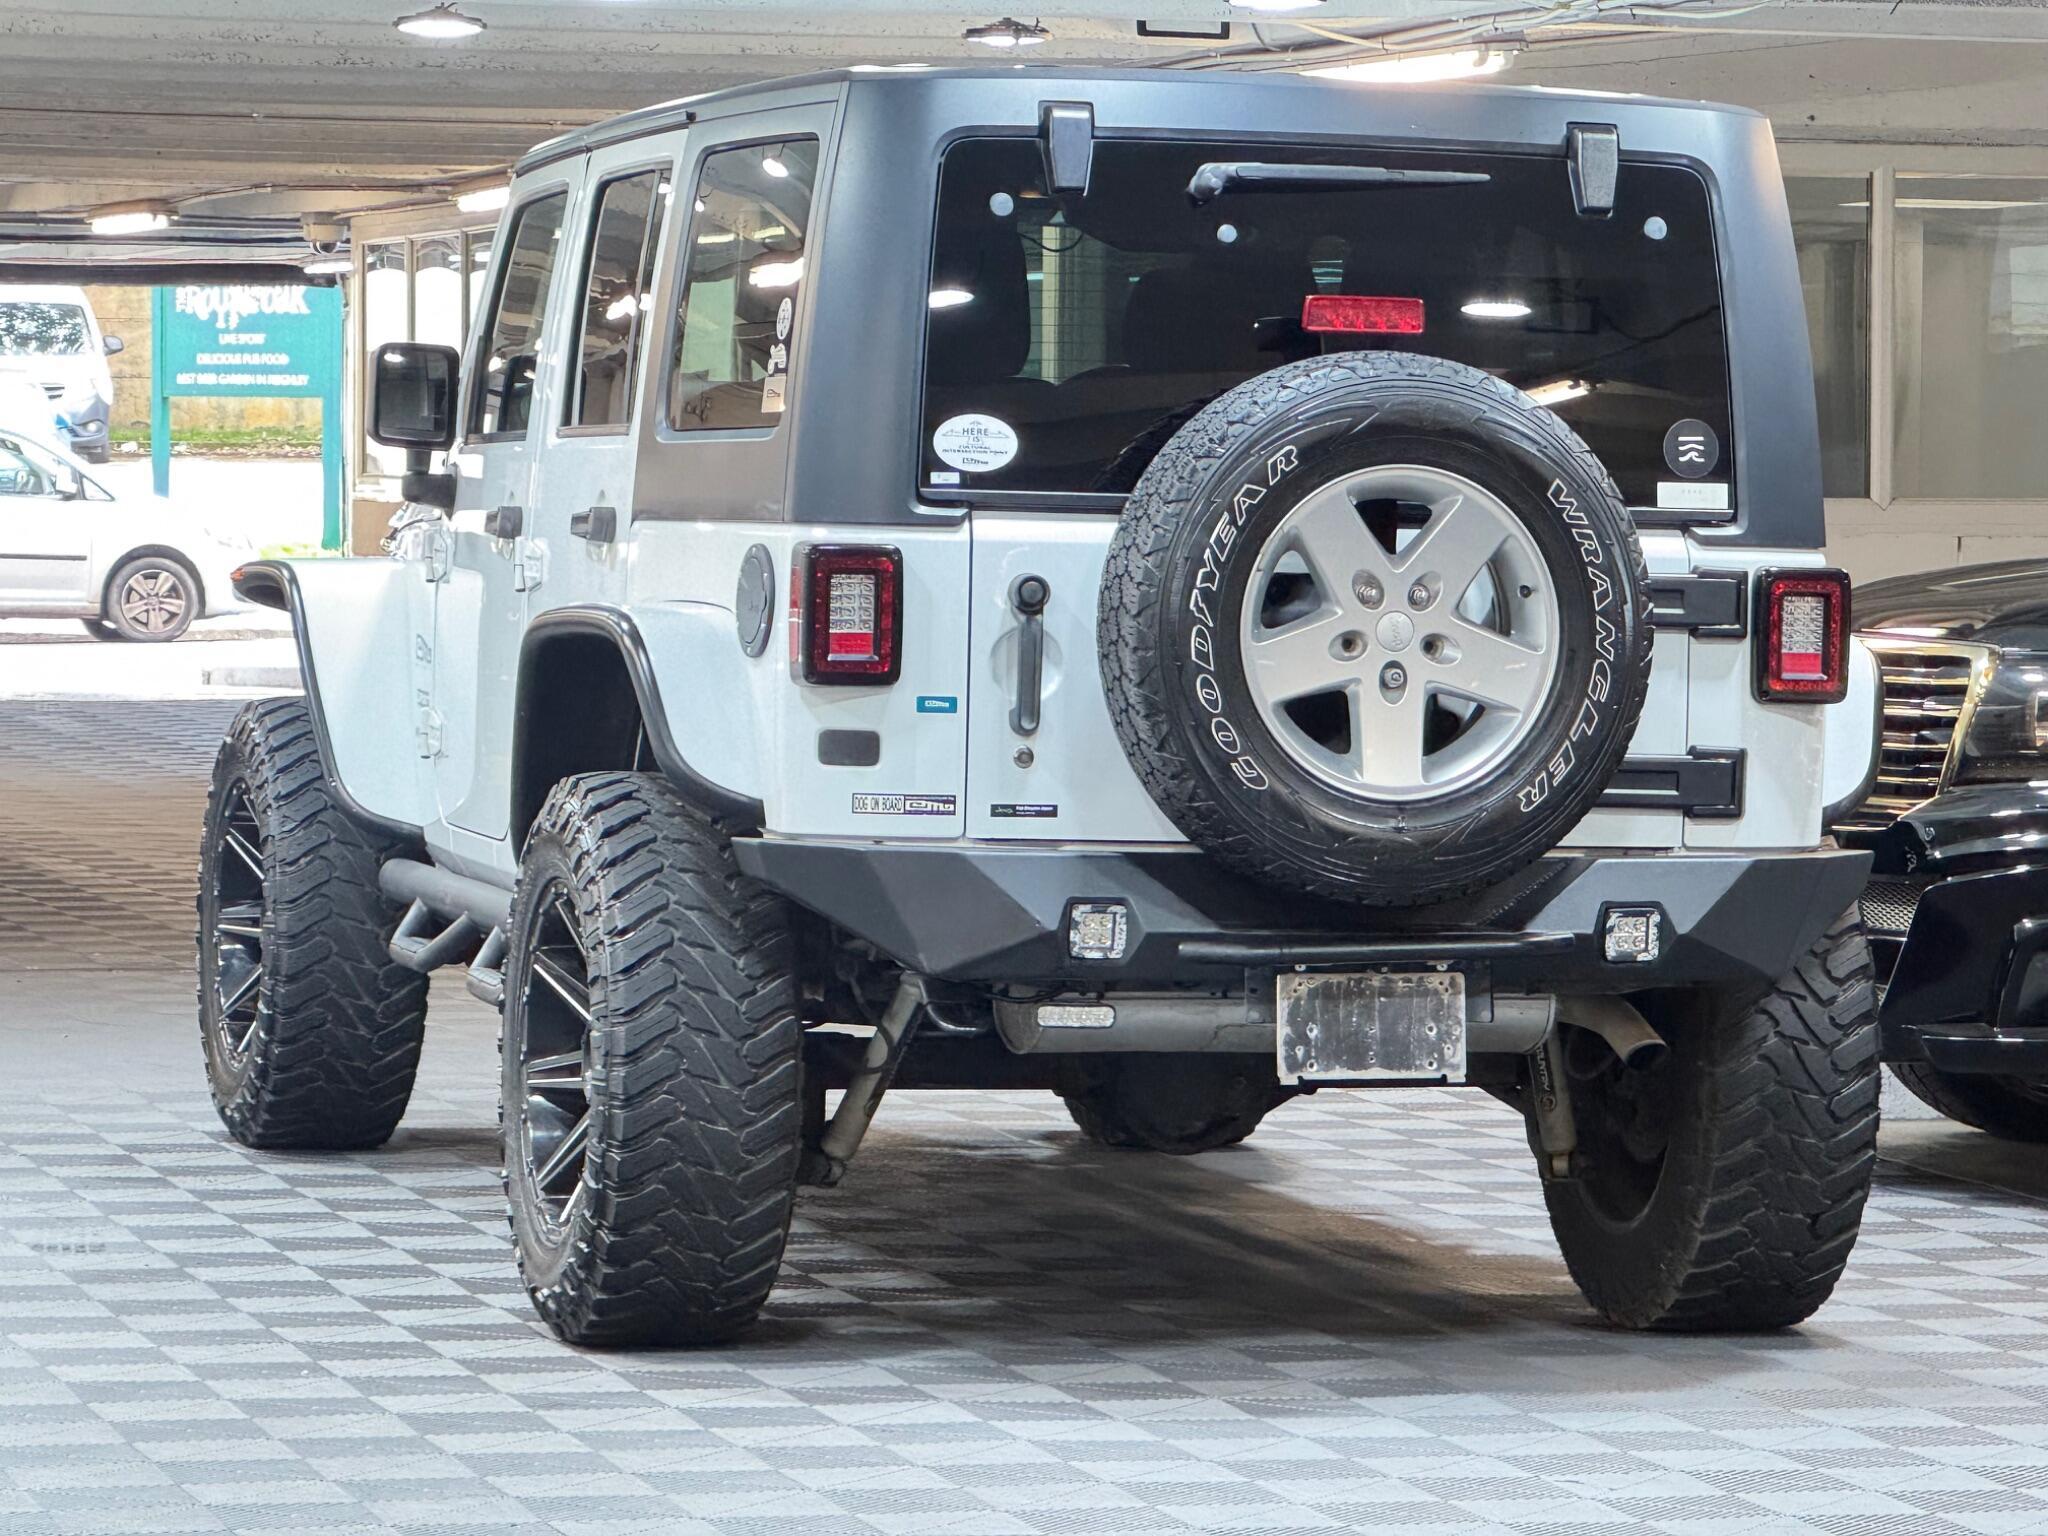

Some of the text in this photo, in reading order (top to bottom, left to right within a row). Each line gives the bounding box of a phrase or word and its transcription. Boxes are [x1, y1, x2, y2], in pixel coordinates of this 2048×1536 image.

[962, 427, 989, 436] HERE
[1189, 445, 1299, 791] GOODYEAR
[1519, 479, 1615, 812] WRANGLER
[854, 796, 868, 811] DOG
[870, 796, 880, 811] ON
[881, 796, 903, 812] BOARD
